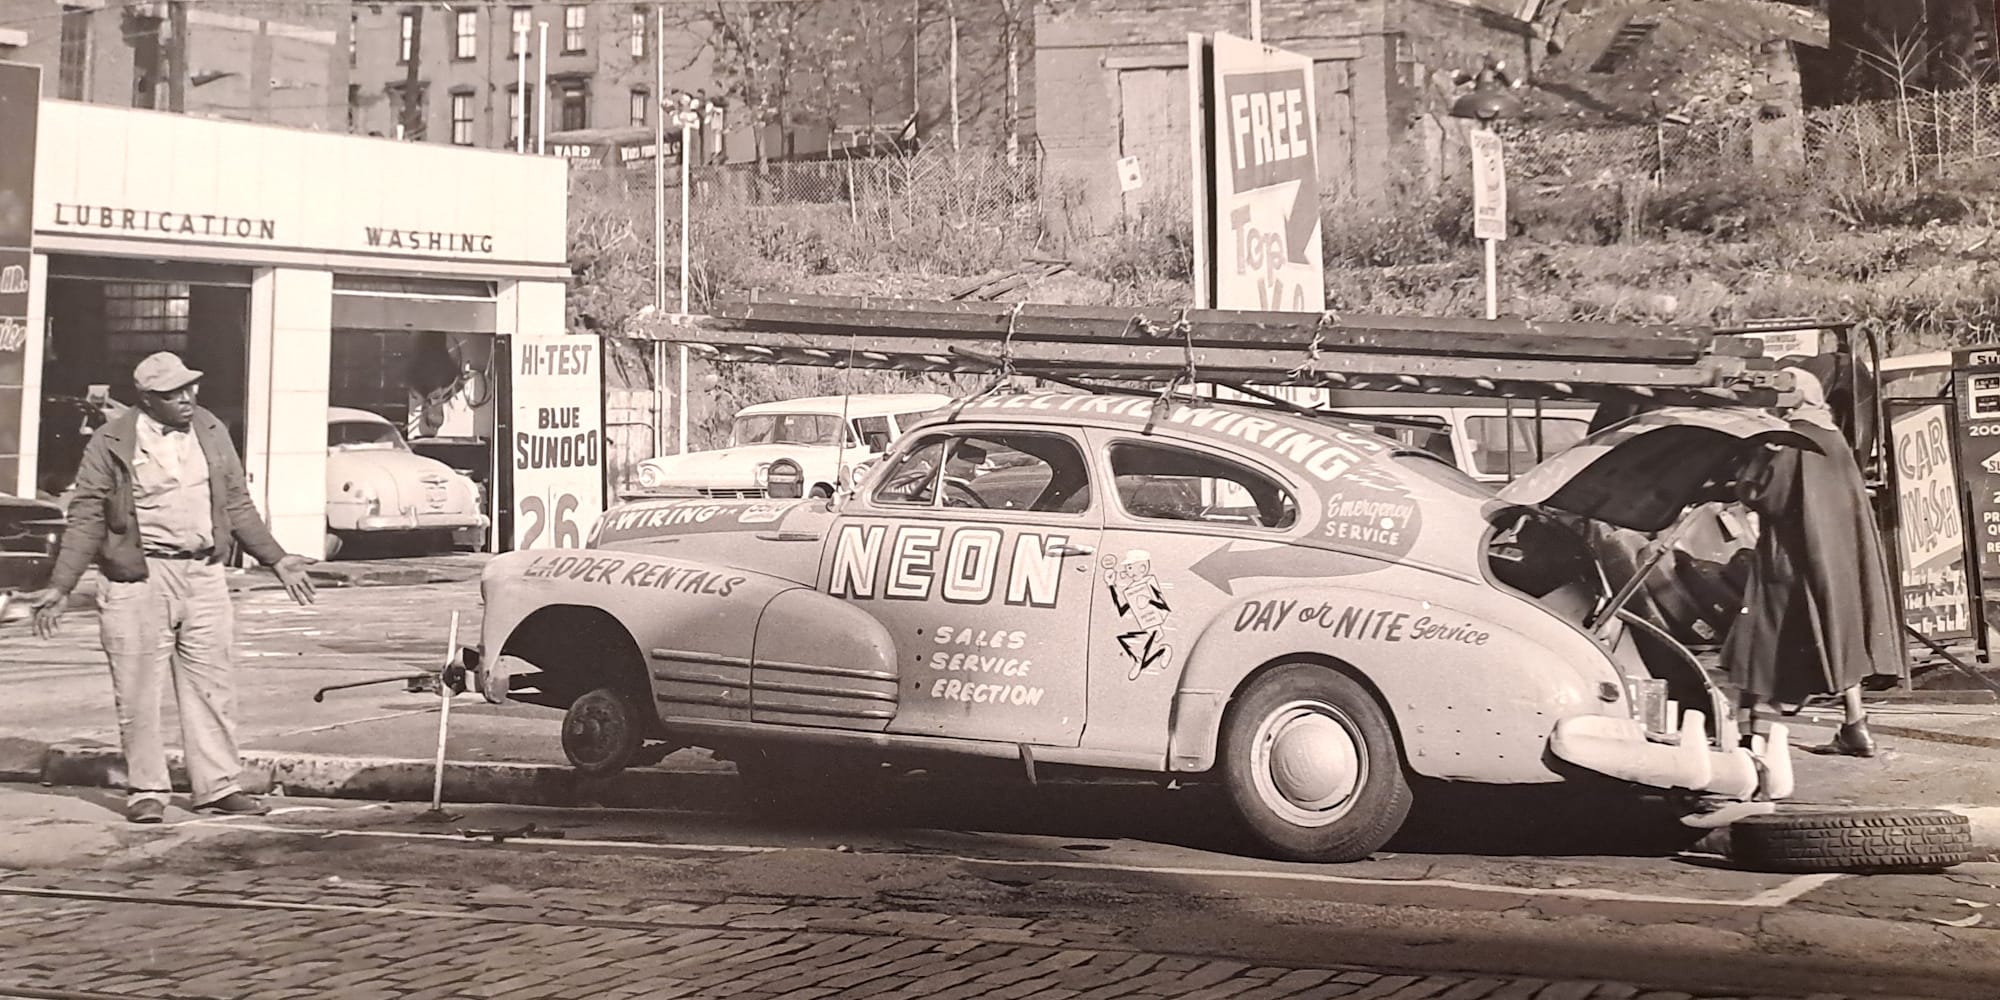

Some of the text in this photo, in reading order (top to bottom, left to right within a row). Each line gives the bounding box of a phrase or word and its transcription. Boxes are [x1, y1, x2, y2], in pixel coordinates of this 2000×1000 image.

[1231, 88, 1307, 170] FREE
[554, 145, 591, 158] WARD
[55, 202, 275, 240] LUBRICATION
[365, 226, 492, 253] WASHING
[1230, 203, 1285, 288] Top
[521, 344, 592, 375] HI-TEST
[538, 407, 580, 429] BLUE
[516, 430, 598, 470] SUNOCO
[1171, 406, 1361, 481] WIRING
[1900, 416, 1946, 480] CAR
[520, 493, 580, 549] 26
[616, 505, 720, 531] WIRING
[1327, 493, 1415, 528] Emergency
[1903, 479, 1958, 552] WASH
[1325, 521, 1399, 545] SERVICE
[523, 557, 746, 597] LADDER RENTALS
[827, 524, 1068, 609] NEON
[934, 626, 1026, 649] SALES
[1234, 600, 1490, 646] DAY or NITE Service
[930, 652, 1032, 677] SERVICE
[931, 679, 1044, 706] ERECTION
